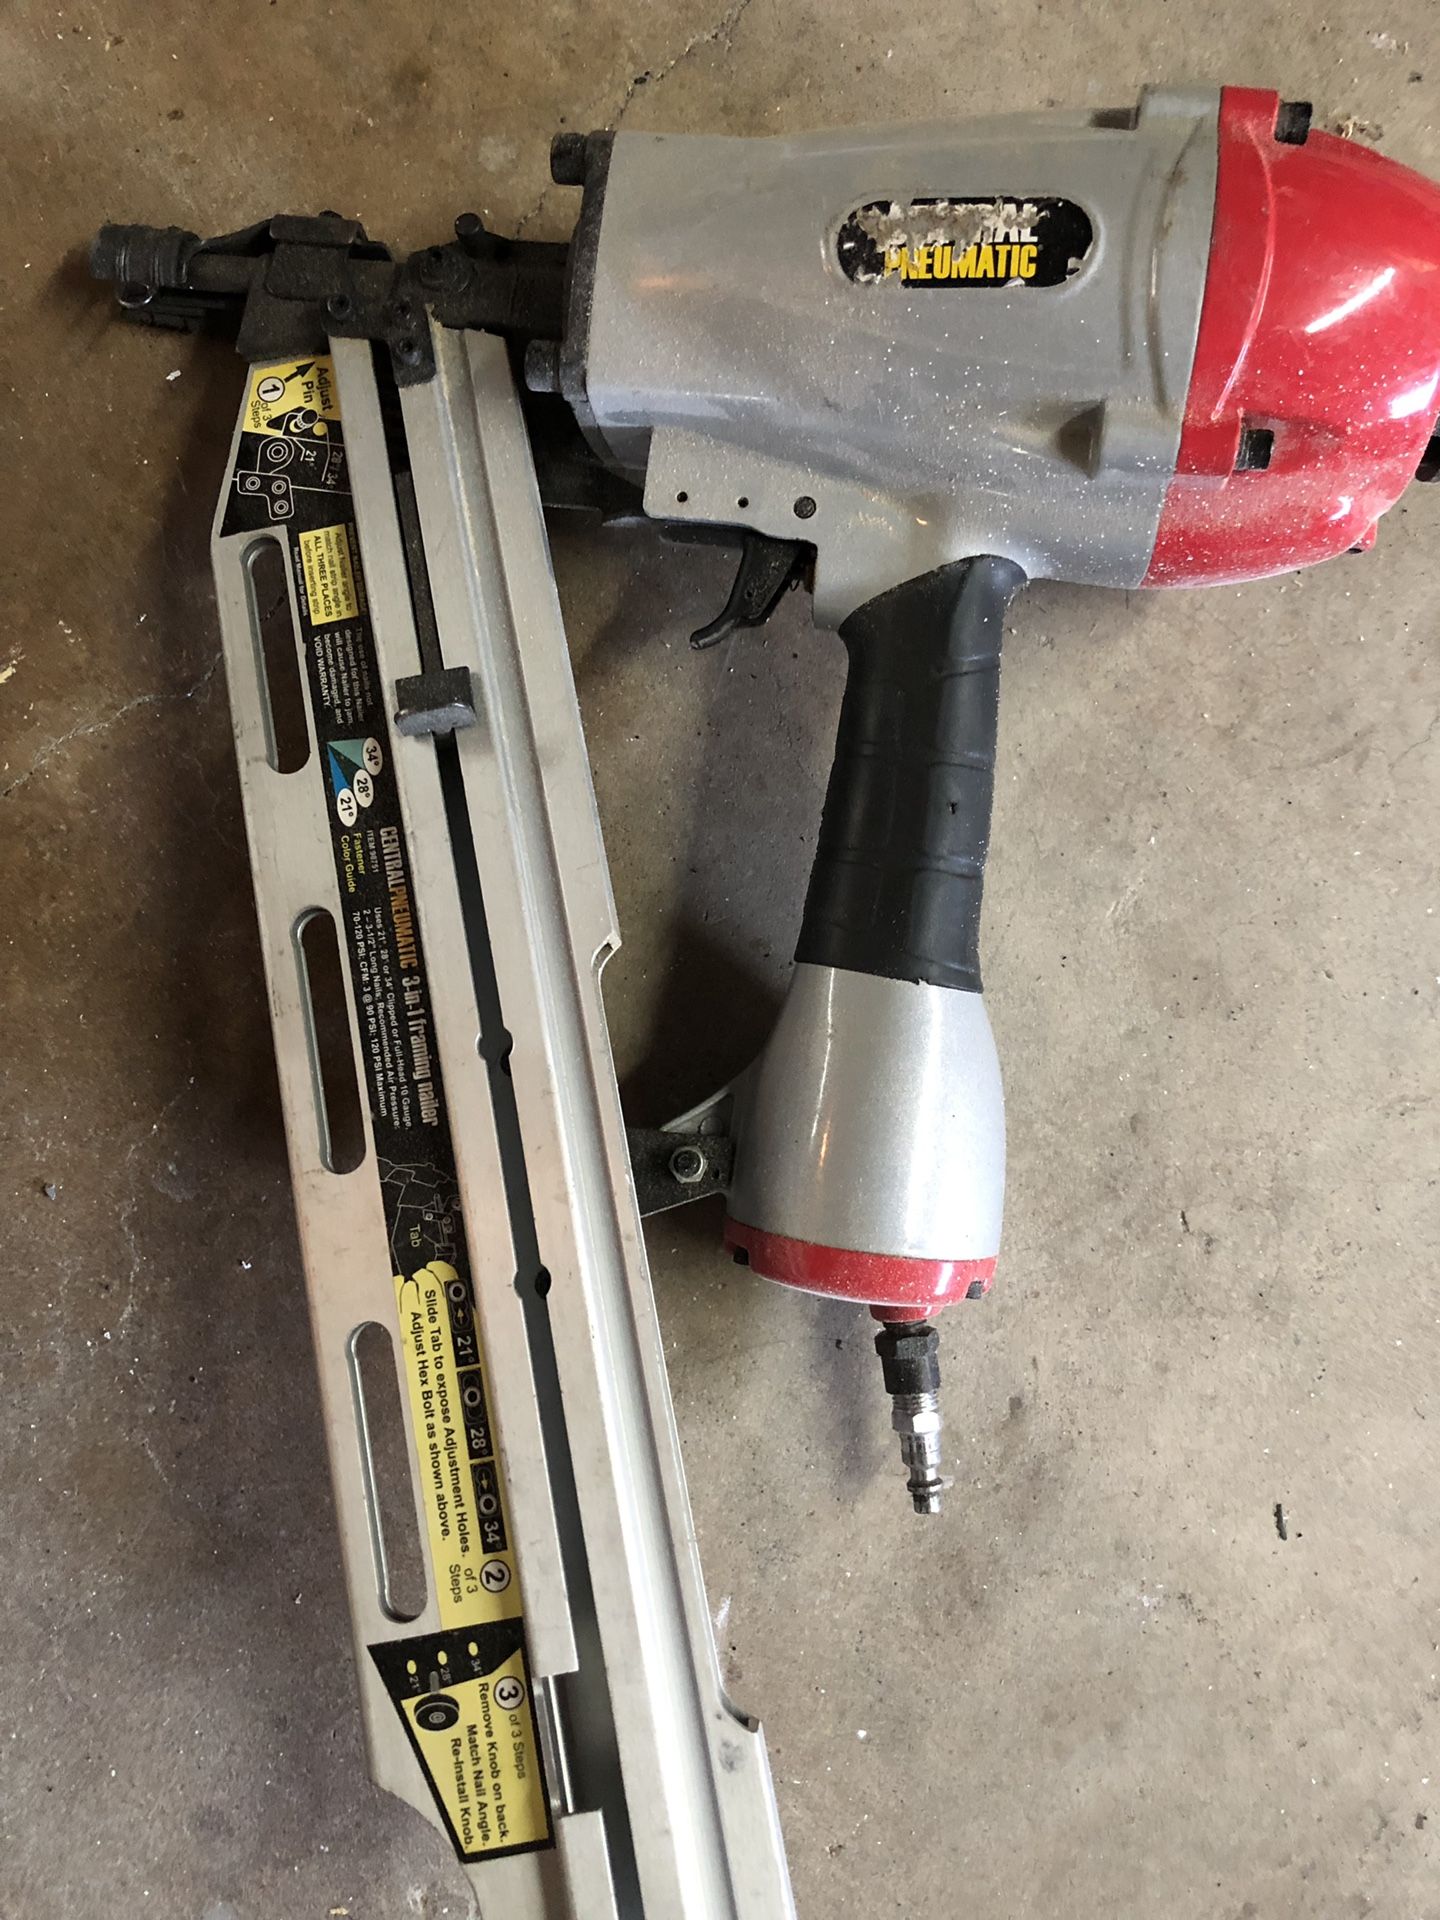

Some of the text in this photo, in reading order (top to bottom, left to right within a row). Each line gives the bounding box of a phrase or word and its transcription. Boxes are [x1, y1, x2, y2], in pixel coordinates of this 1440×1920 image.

[262, 384, 280, 394] 1
[302, 381, 314, 403] Pin
[316, 367, 333, 411] Adjust
[251, 400, 261, 428] Steps
[261, 403, 270, 412] of
[324, 531, 333, 553] match
[335, 533, 344, 555] Adjust
[328, 555, 336, 567] nail
[304, 540, 320, 614] before inserting strip
[314, 536, 332, 617] ALL THREE PLACES
[330, 570, 338, 586] strip
[295, 564, 303, 584] Manual
[300, 596, 308, 616] Details
[332, 588, 341, 608] angle
[342, 581, 351, 601] angle
[346, 603, 352, 611] to
[314, 636, 323, 656] VOID
[345, 629, 356, 666] designed
[337, 647, 345, 671] cause
[341, 673, 349, 695] Nailer
[345, 698, 351, 706] to
[360, 661, 368, 669] of
[324, 634, 343, 724] become damaged, and
[353, 681, 361, 696] this
[356, 698, 364, 722] Nailer
[366, 746, 379, 766] 34°
[357, 778, 371, 798] 28°
[340, 797, 354, 817] 21°
[366, 830, 376, 849] ITEM
[341, 835, 356, 893] Color Guide
[354, 833, 366, 874] Fastener
[352, 912, 365, 939] 70-120
[374, 907, 385, 928] Uses
[360, 961, 370, 985] CFM:
[383, 965, 389, 974] or
[362, 993, 372, 1004] @
[402, 976, 425, 1016] 3-in-1
[366, 1005, 375, 1015] 90
[369, 951, 379, 973] Long
[377, 1002, 393, 1068] Recommended
[387, 1071, 395, 1082] Air
[386, 993, 398, 1026] Clipped
[371, 1038, 381, 1053] 120
[392, 1029, 399, 1038] or
[394, 1040, 408, 1082] Full-Head
[407, 1019, 432, 1080] framing
[373, 1056, 382, 1070] PSI
[376, 1074, 388, 1116] Maximum
[401, 1086, 409, 1095] 10
[417, 1082, 439, 1126] nailer
[409, 1224, 421, 1247] Tab
[457, 1336, 474, 1363] 21°
[411, 1312, 450, 1540] Adjust Hex Bolt as shown above.
[425, 1290, 470, 1557] Slide Tab to expose Adjustment Holes.
[470, 1427, 488, 1455] 28°
[484, 1521, 502, 1549] 34°
[449, 1564, 463, 1603] Steps
[464, 1568, 478, 1594] of 3
[485, 1569, 505, 1584] 2
[499, 1686, 526, 1779] 3 of 3 Steps
[478, 1682, 509, 1842] Remove Knob on back.
[451, 1738, 474, 1849] Re-Install Knob.
[467, 1724, 491, 1846] Match Nail Angle.
